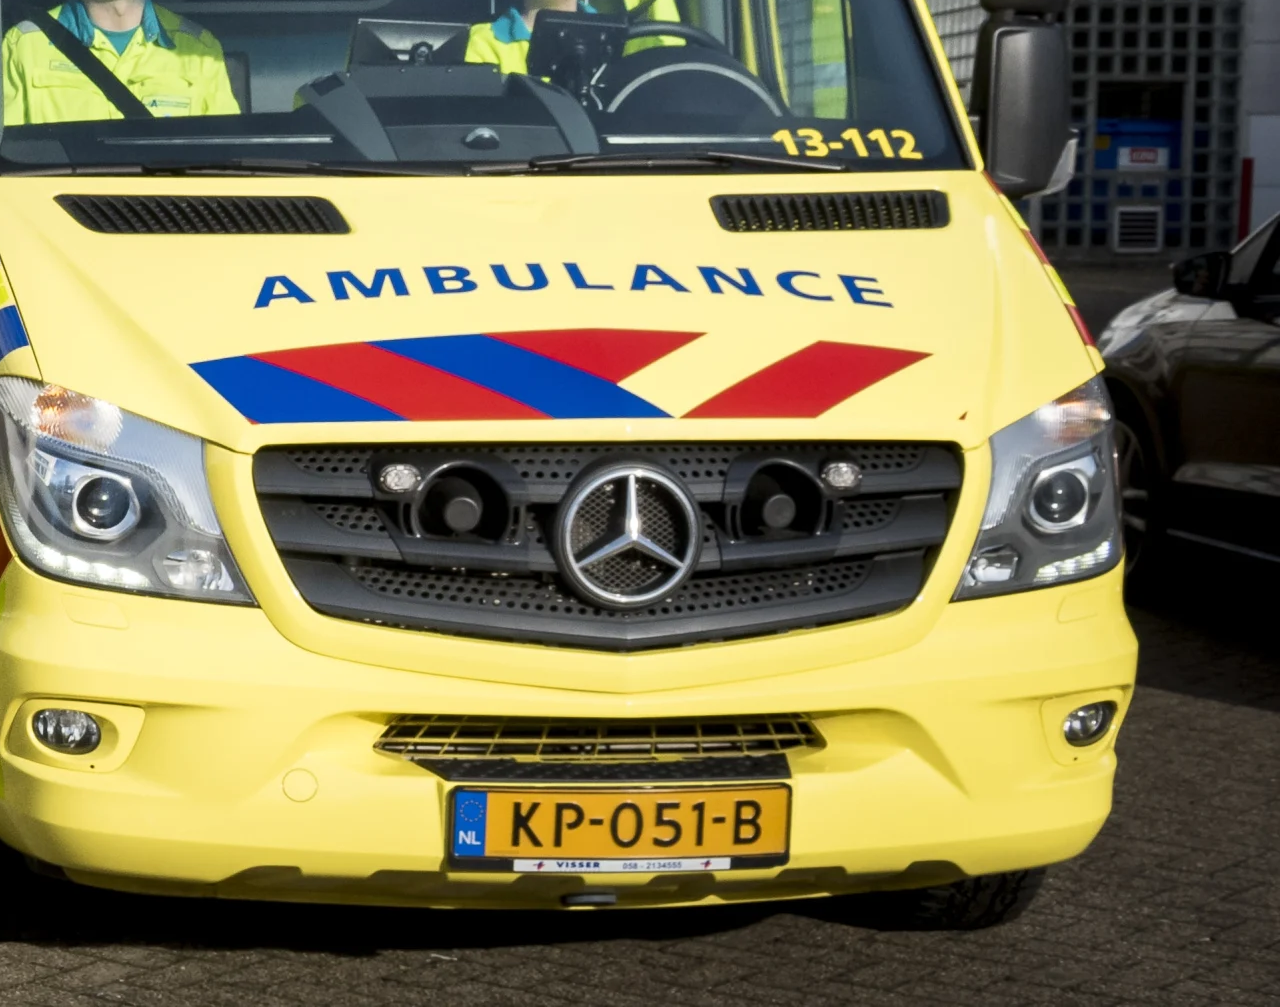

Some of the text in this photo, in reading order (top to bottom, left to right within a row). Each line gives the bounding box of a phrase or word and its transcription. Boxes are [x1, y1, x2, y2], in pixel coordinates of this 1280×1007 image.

[772, 128, 924, 160] 13-112
[253, 261, 895, 309] AMBULANCE
[458, 830, 482, 845] NL
[511, 799, 762, 848] KP-051-B
[556, 861, 600, 869] VISSER
